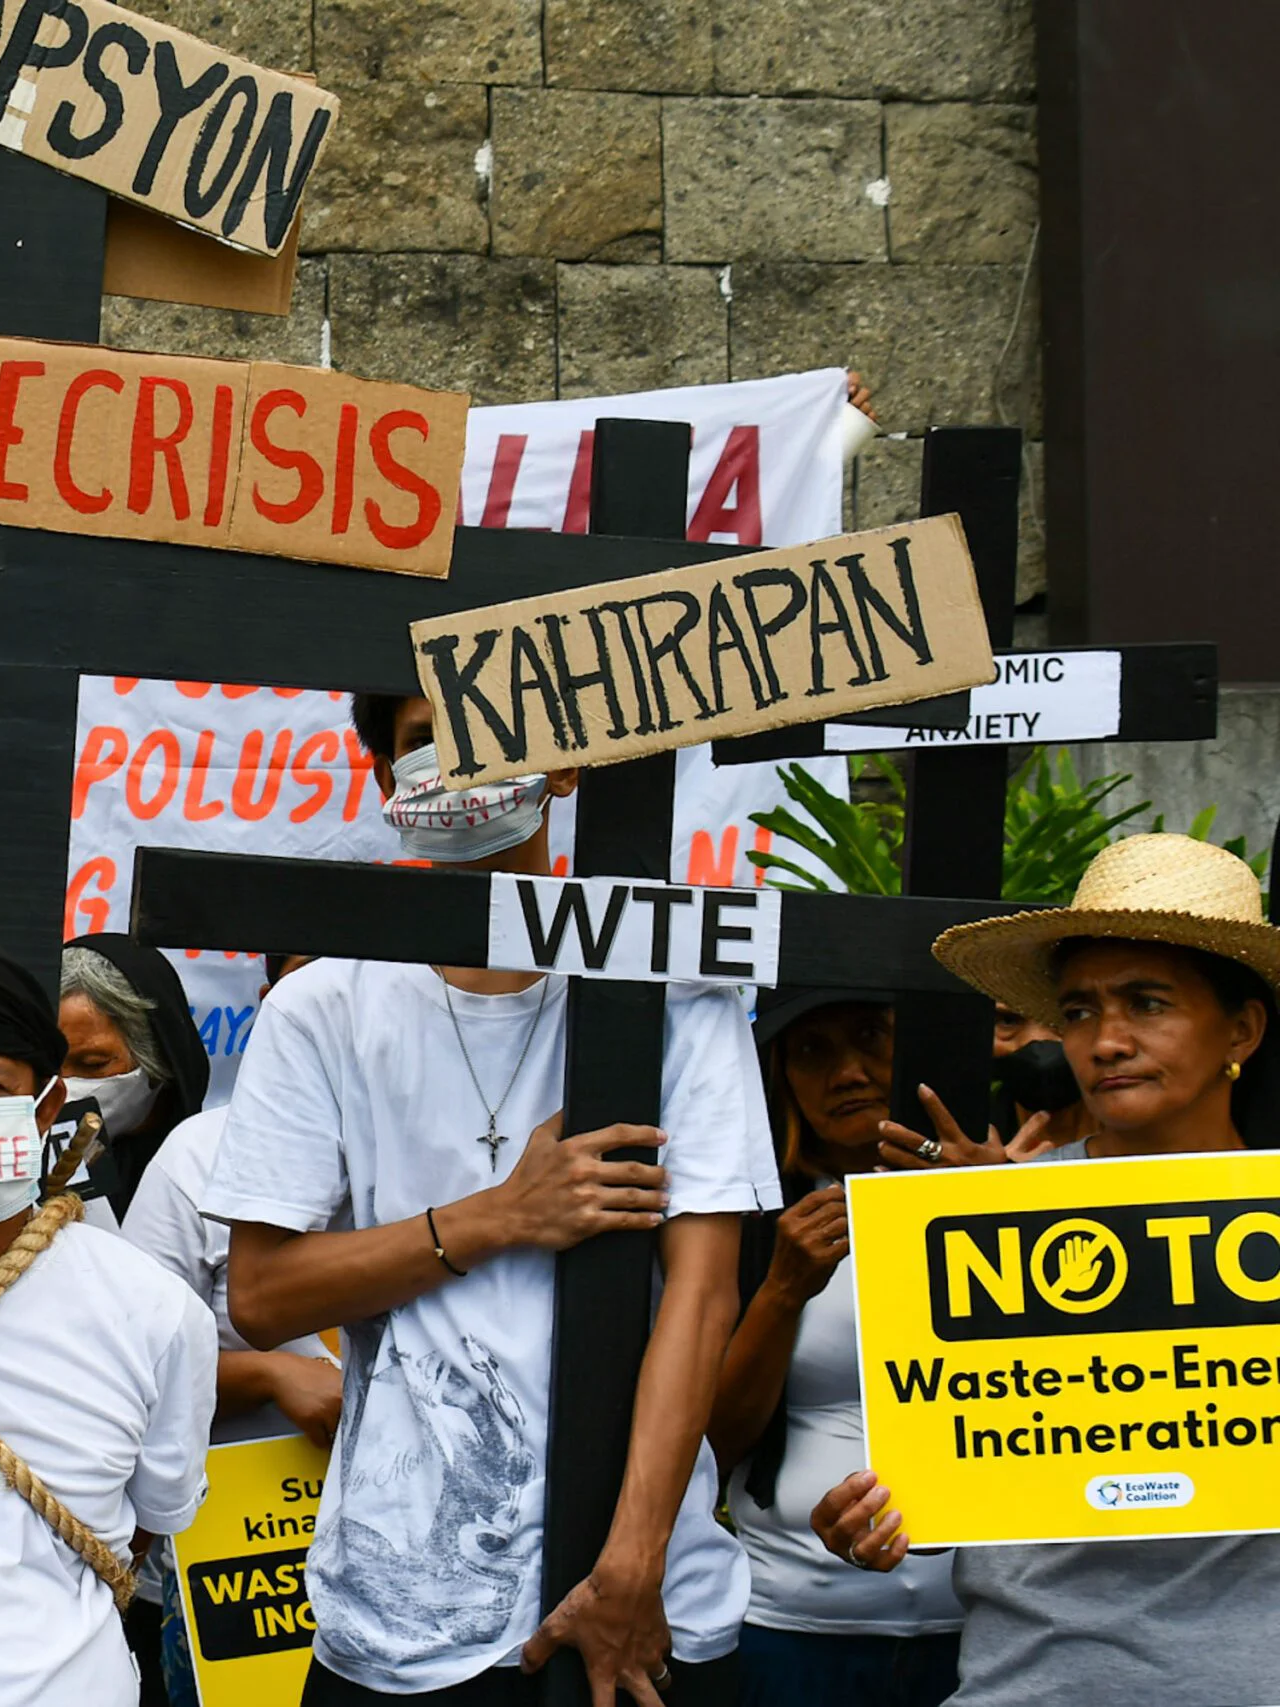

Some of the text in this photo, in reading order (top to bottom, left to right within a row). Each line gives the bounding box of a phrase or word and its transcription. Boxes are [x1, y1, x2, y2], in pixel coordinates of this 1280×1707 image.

[53, 369, 442, 551] CRISIS
[421, 537, 933, 778] KAHIRAPAN
[71, 725, 388, 824] POLUSY
[516, 879, 758, 978] WTE
[944, 1211, 1280, 1318] NO TO
[885, 1345, 1280, 1404] Waste-to-Ene
[1125, 1481, 1180, 1492] EcoWaste
[1126, 1491, 1177, 1502] Coalition
